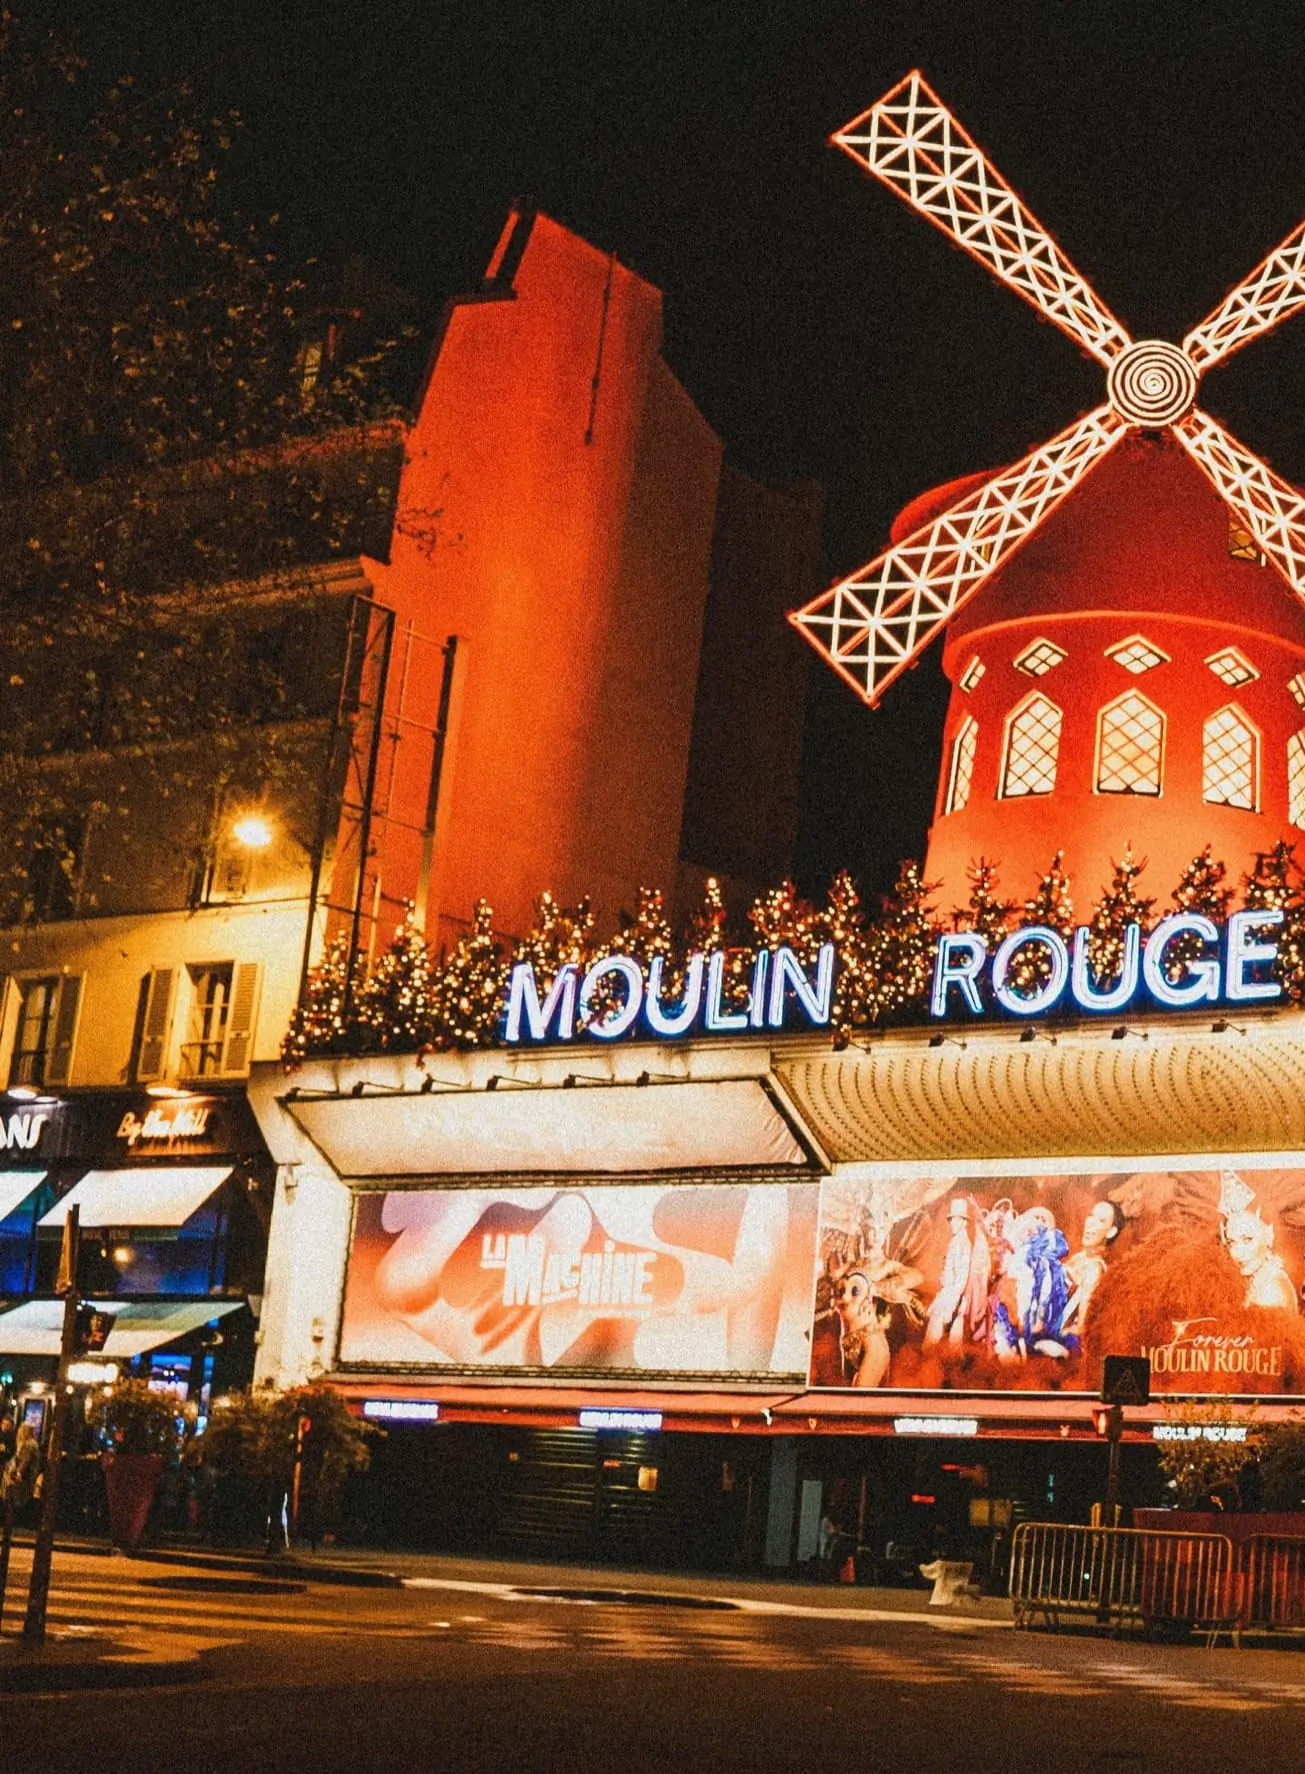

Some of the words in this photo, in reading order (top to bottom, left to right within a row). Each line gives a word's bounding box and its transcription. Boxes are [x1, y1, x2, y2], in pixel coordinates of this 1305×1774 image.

[505, 943, 834, 1042] MOULIN
[930, 911, 1284, 1017] ROUGE
[1160, 1317, 1255, 1350] Forever
[1213, 1347, 1282, 1376] ROUGE
